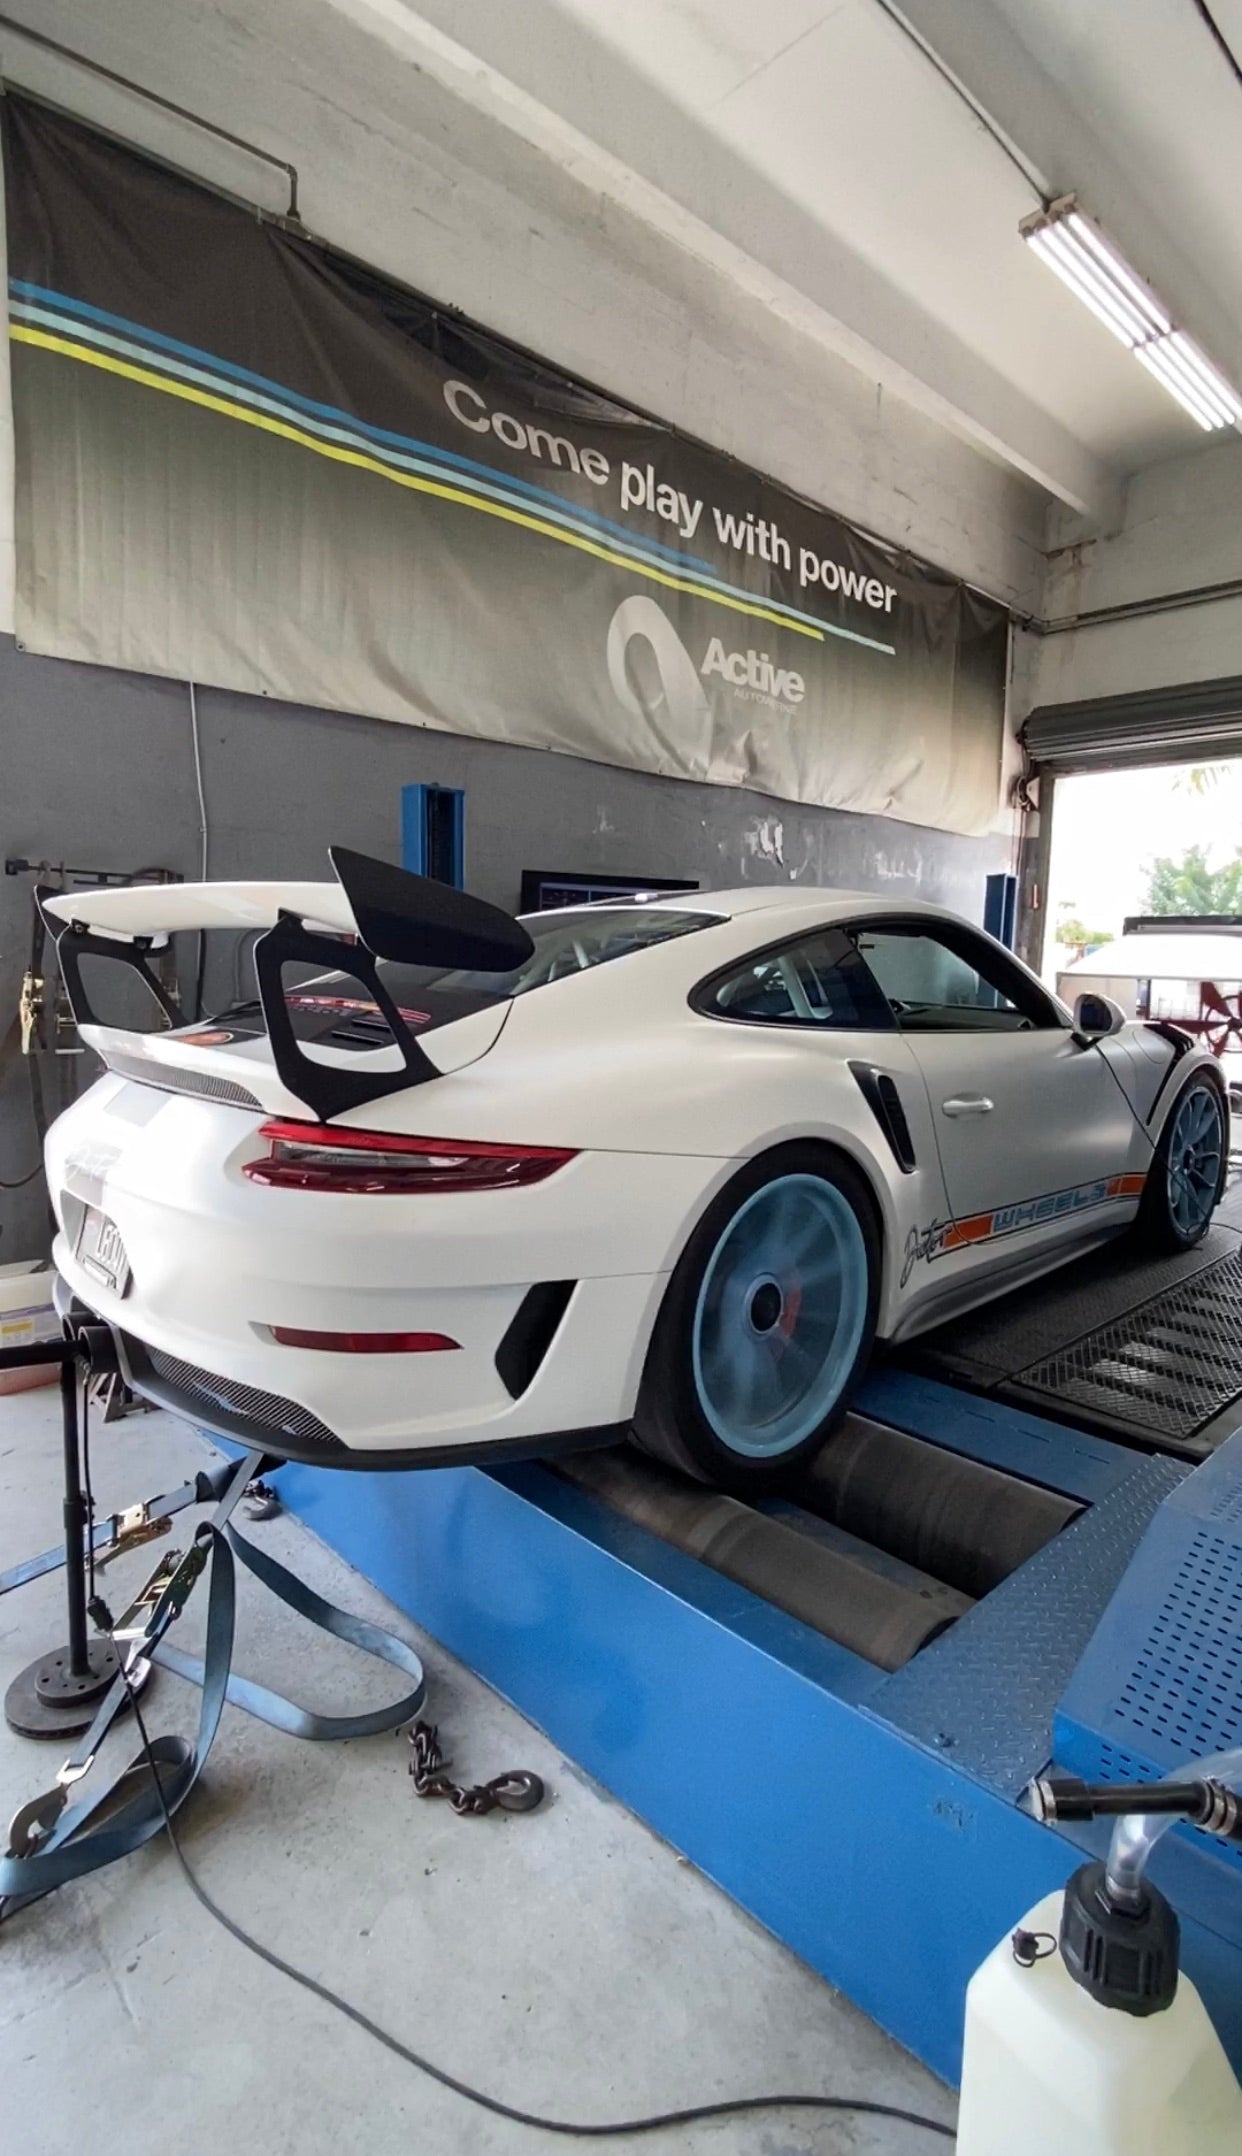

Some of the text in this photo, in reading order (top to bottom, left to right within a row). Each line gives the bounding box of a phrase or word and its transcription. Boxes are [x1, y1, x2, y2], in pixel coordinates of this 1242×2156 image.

[442, 379, 898, 613] Come play with power
[700, 636, 806, 703] Active
[992, 1182, 1108, 1234] WHEELS
